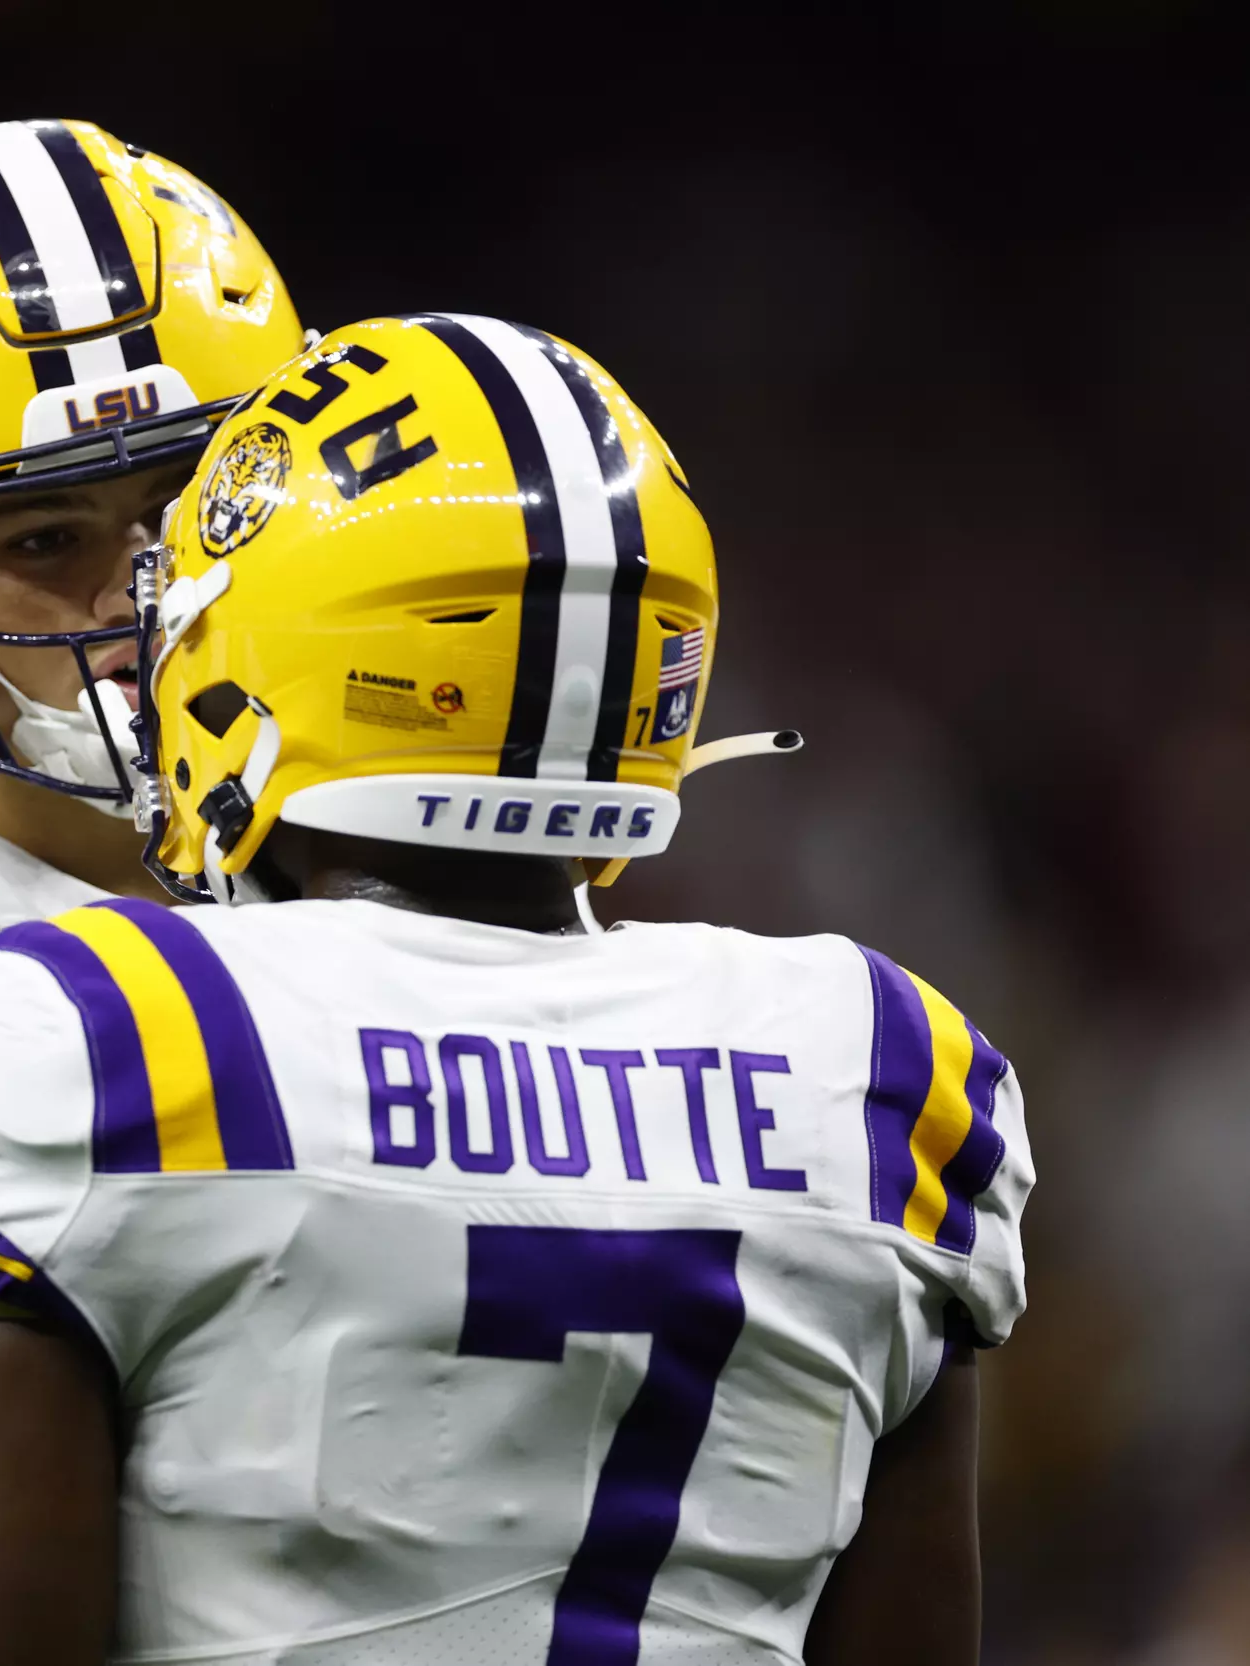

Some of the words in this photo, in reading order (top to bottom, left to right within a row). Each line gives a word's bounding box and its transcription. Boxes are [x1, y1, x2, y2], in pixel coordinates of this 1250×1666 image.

[63, 381, 160, 434] LSU
[228, 344, 439, 501] SU
[361, 671, 417, 691] DANGER
[634, 706, 651, 748] 7
[417, 793, 656, 838] TIGERS
[358, 1027, 808, 1192] BOUTTE
[457, 1225, 744, 1666] 7
